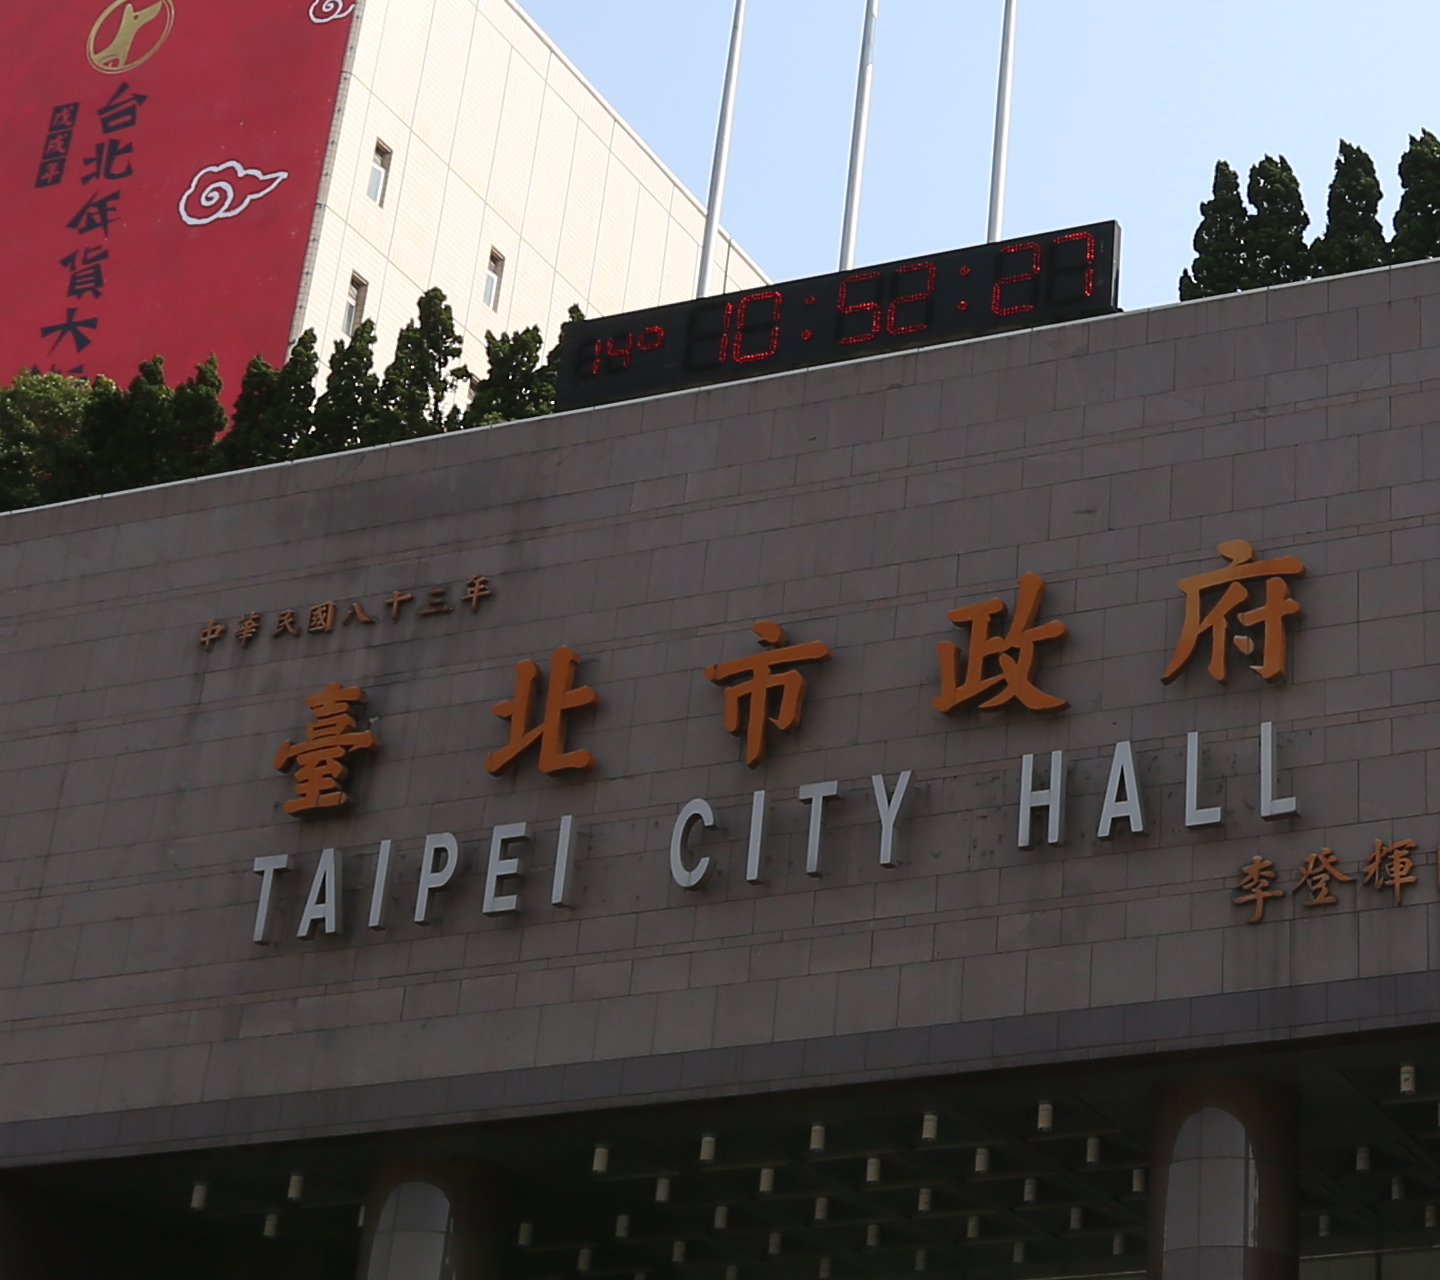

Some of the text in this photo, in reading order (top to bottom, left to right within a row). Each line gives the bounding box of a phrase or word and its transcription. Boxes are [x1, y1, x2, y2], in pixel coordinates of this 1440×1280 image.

[718, 231, 1096, 365] 10:52:27
[197, 572, 493, 651] 中華民國八十三年
[274, 538, 1307, 817] 臺北市政府
[253, 721, 1300, 945] TAIPEI CITY HALL
[1232, 837, 1419, 924] 李登輝
